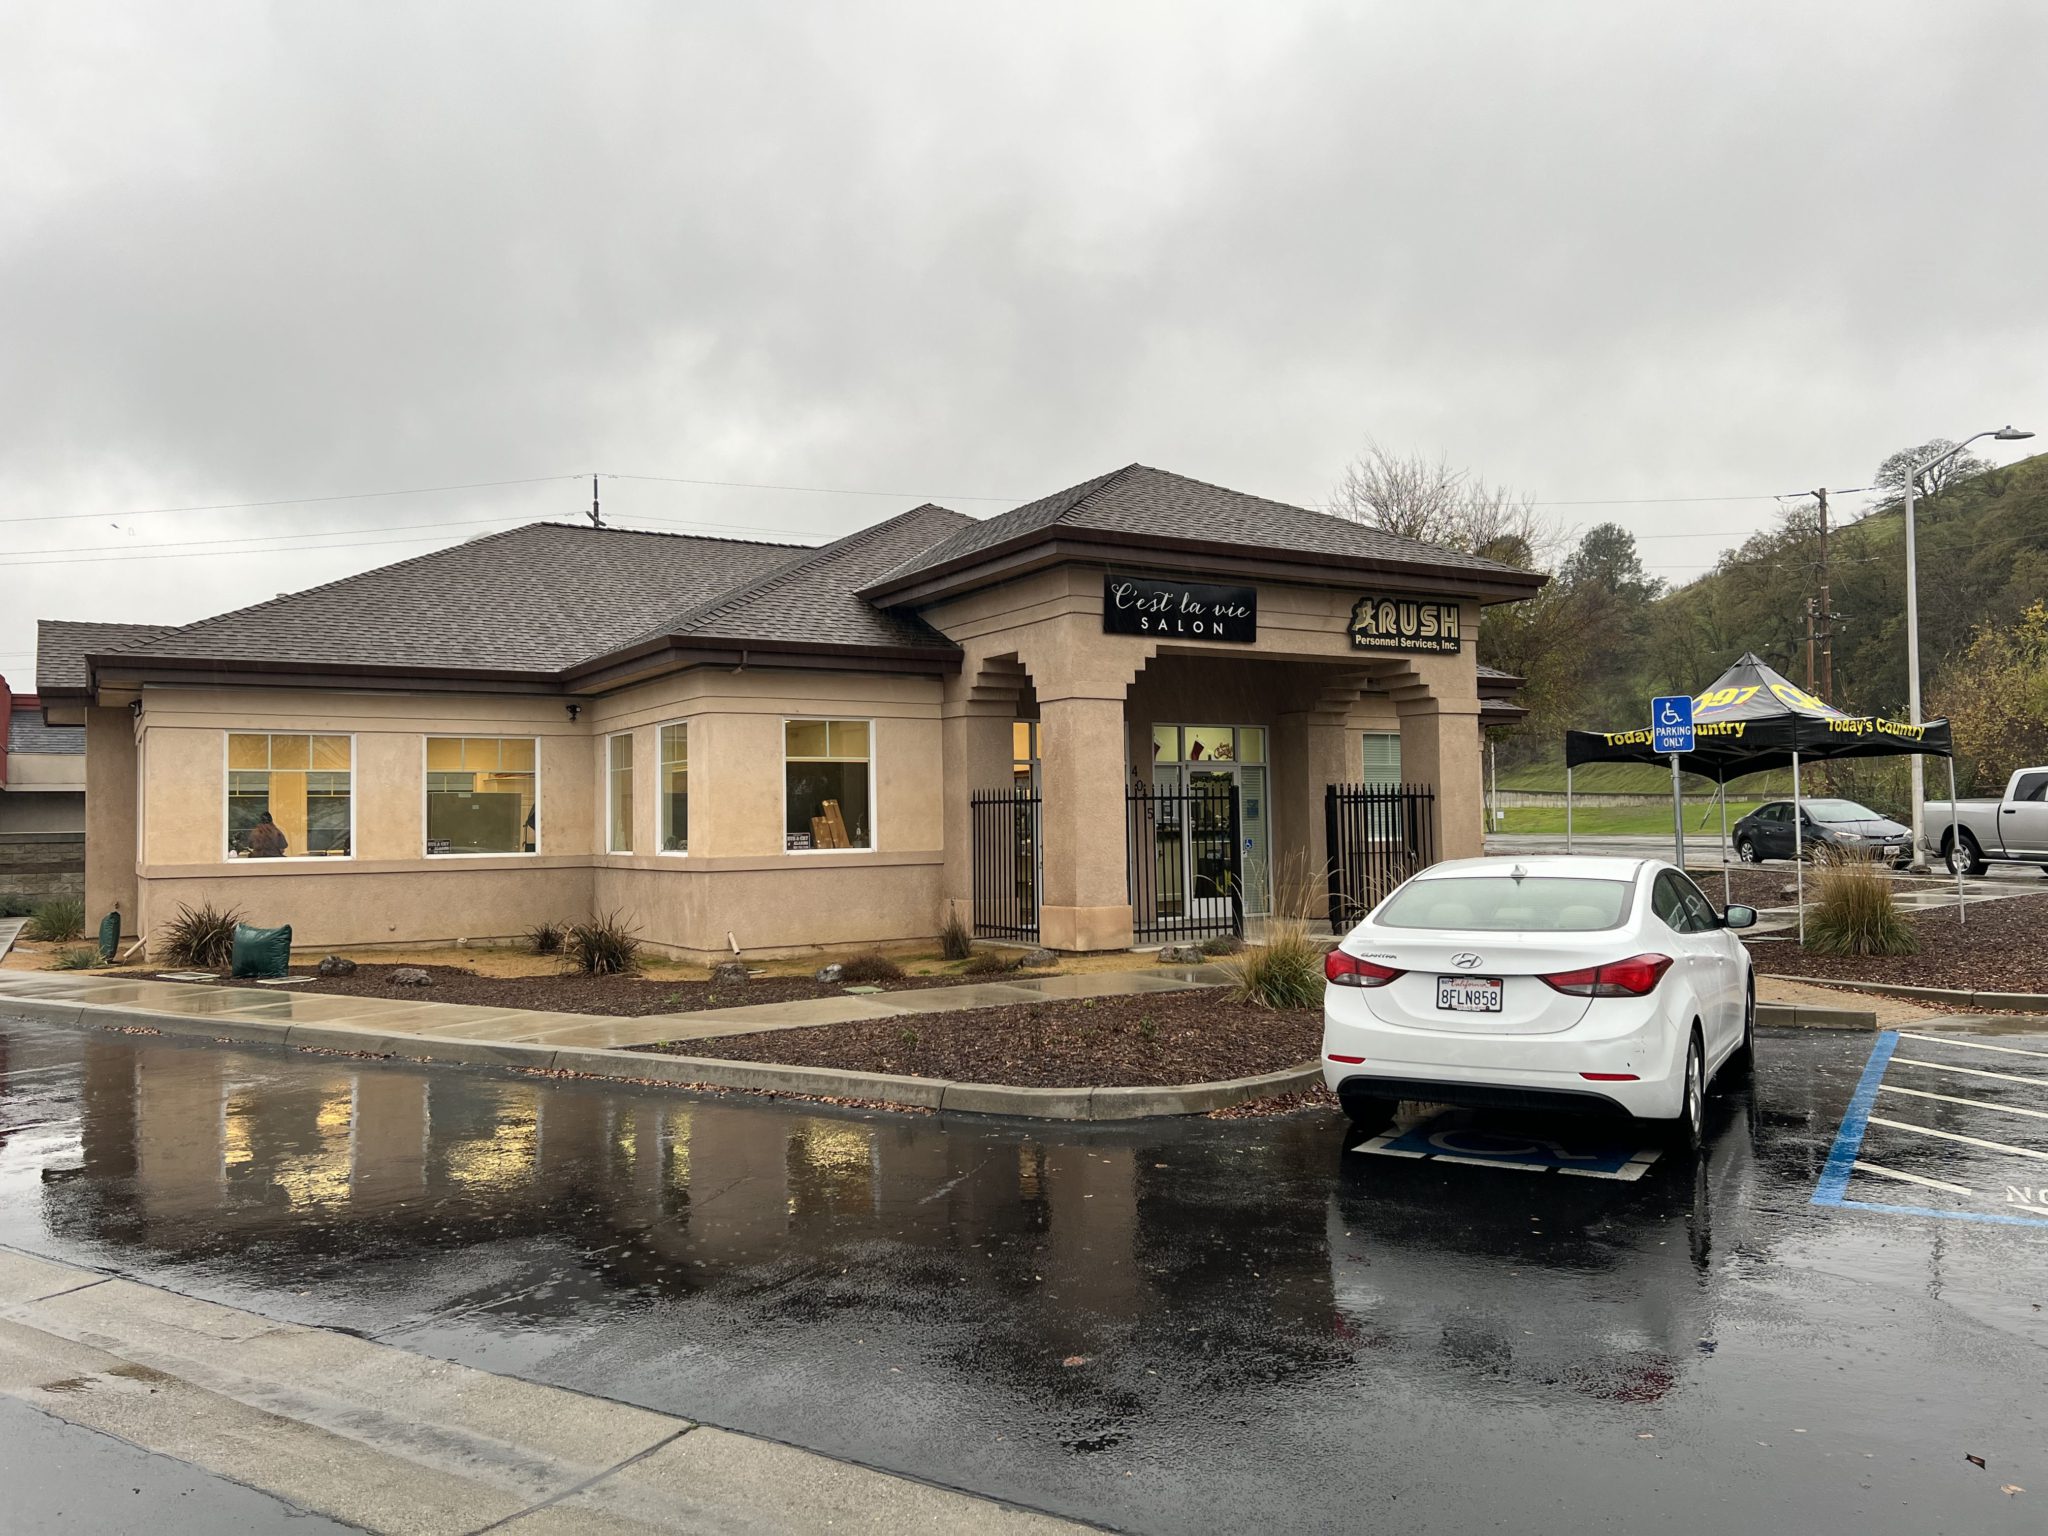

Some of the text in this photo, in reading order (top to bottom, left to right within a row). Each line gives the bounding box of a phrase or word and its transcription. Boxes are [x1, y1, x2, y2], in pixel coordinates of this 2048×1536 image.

[1111, 582, 1251, 618] C'est la vie
[1141, 616, 1223, 635] SALON
[1378, 601, 1459, 638] RUSH
[1355, 634, 1458, 651] Personnel Services, Inc.
[1656, 726, 1691, 737] PARKING
[1824, 717, 1925, 741] Today's Country
[1603, 730, 1654, 747] Today
[1663, 737, 1685, 748] ONLY
[1441, 989, 1498, 1006] 8FLN858
